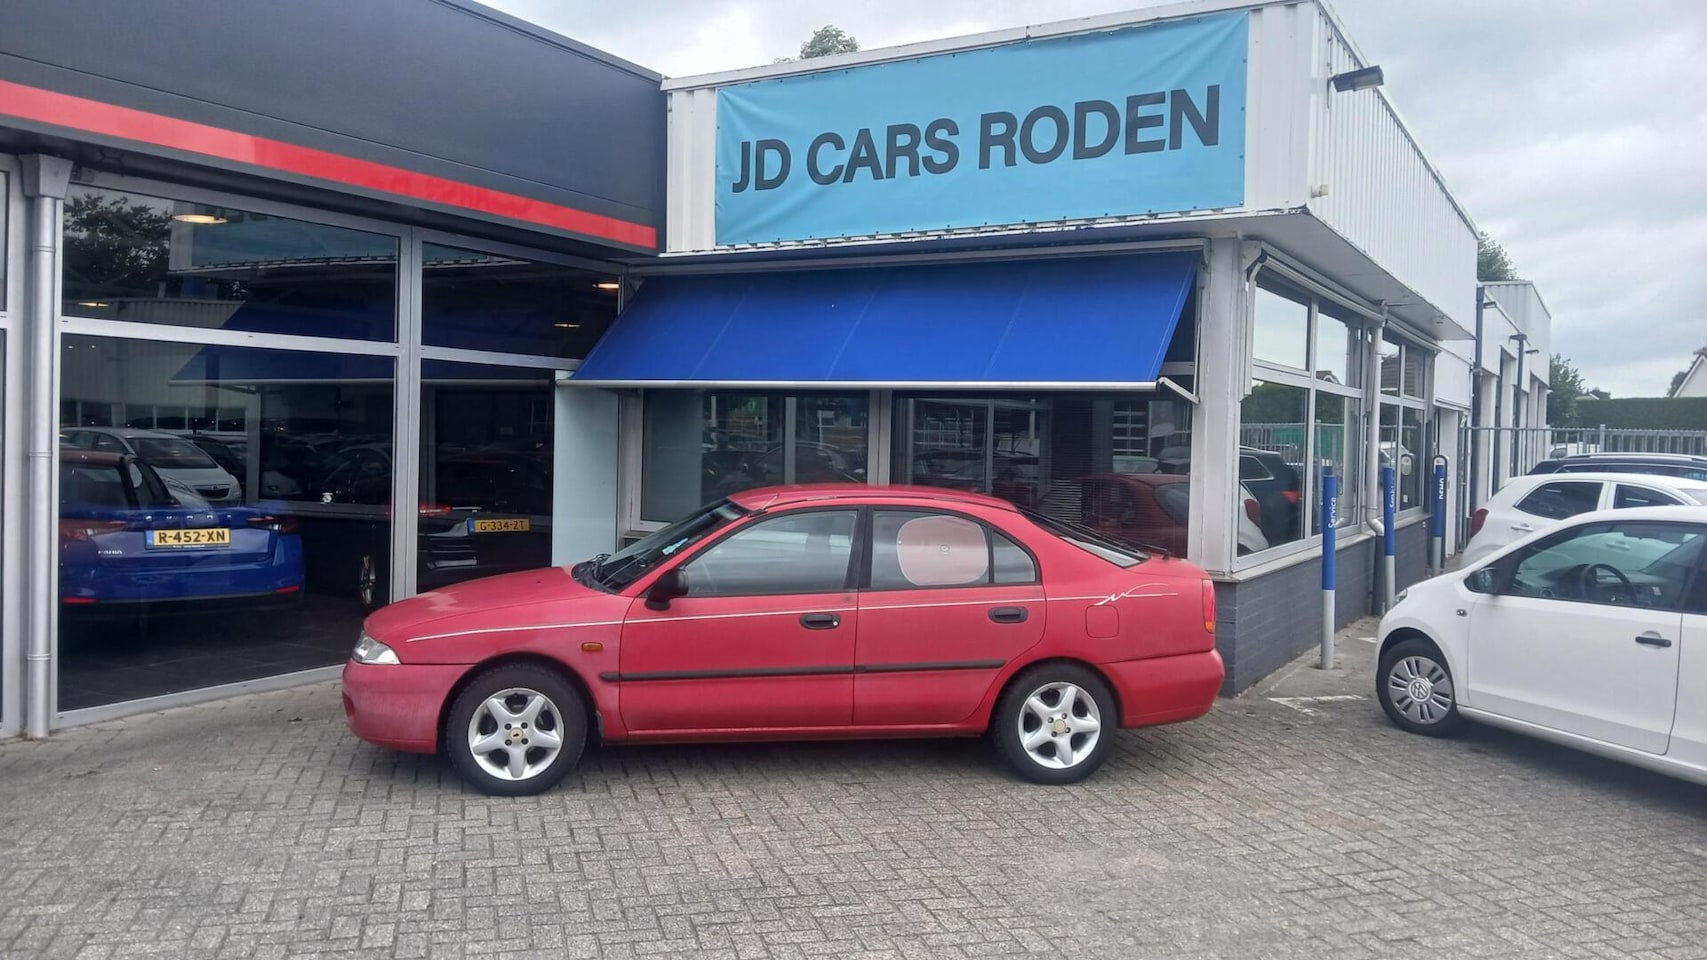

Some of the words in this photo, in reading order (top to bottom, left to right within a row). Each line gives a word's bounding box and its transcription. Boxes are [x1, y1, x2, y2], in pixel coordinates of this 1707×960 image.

[732, 138, 792, 193] JD
[806, 118, 960, 187] CARS
[978, 84, 1220, 170] RODEN
[1328, 496, 1337, 529] Service
[158, 530, 225, 544] R-452-XN
